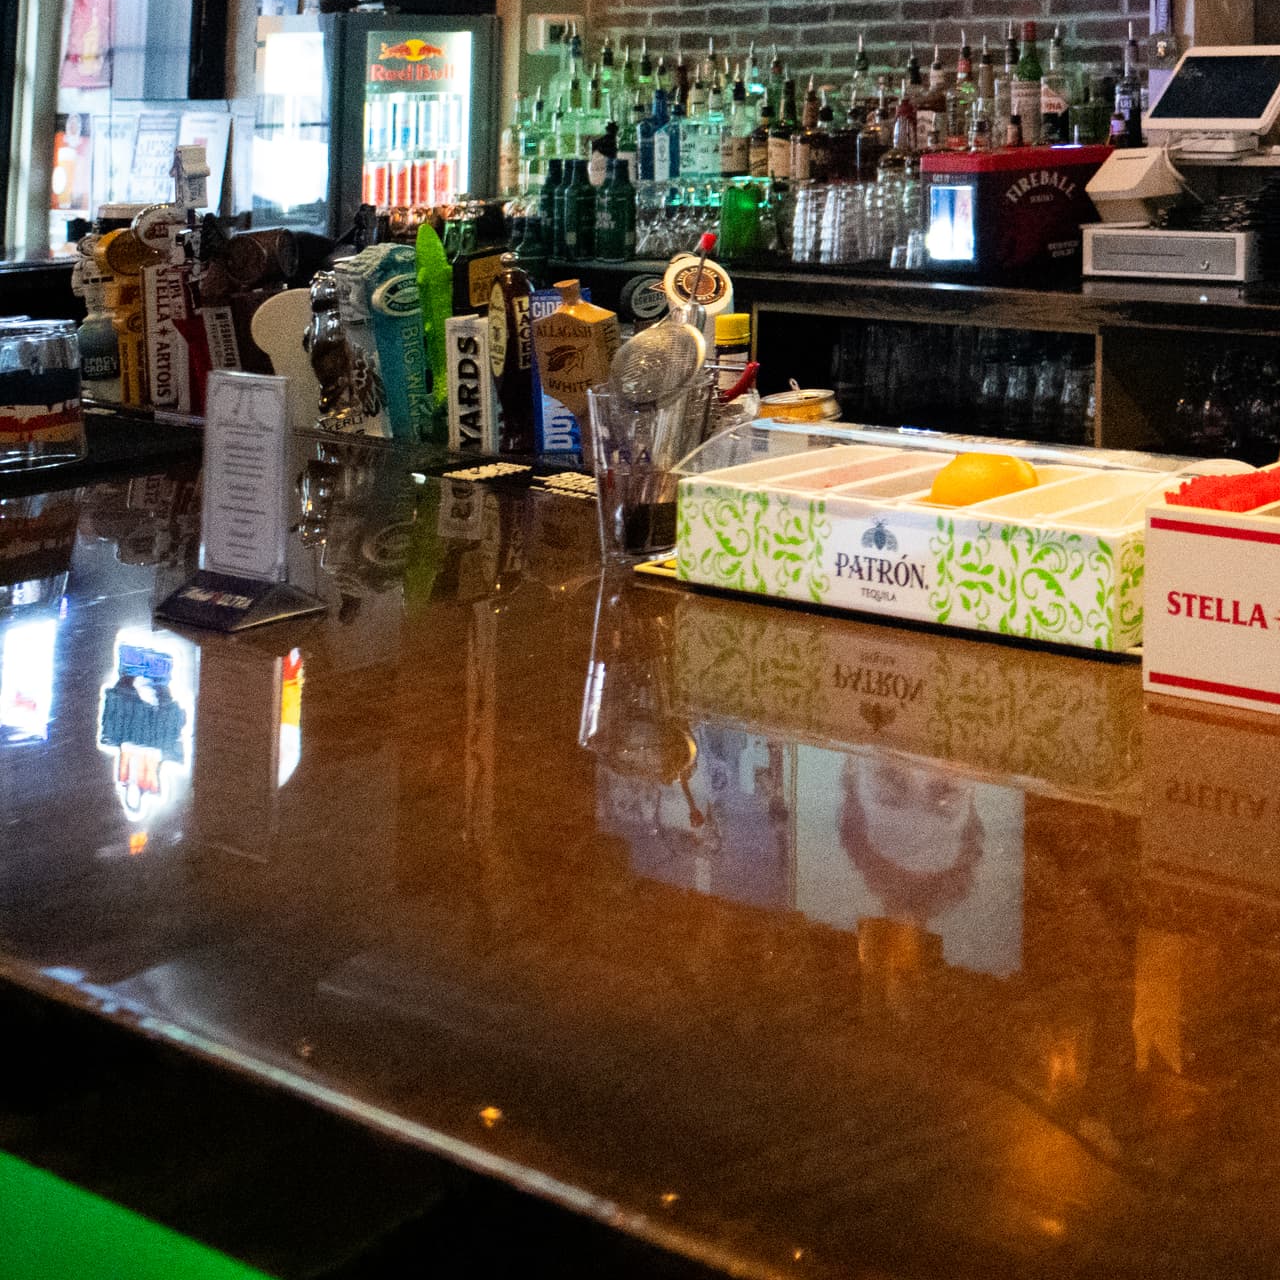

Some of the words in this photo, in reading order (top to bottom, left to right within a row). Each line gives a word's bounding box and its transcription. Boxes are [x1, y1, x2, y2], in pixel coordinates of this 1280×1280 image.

[370, 64, 412, 81] Red
[417, 64, 455, 81] Bull
[1006, 170, 1077, 205] FIREBALL
[155, 268, 167, 323] STELLA
[402, 325, 421, 365] BIG
[513, 296, 532, 370] LAGER
[537, 325, 593, 338] ALLAGASH
[155, 341, 172, 399] ARTOIS
[550, 379, 593, 394] WHITE
[458, 336, 481, 448] YARDS
[861, 587, 897, 602] TEQUILA
[1167, 590, 1269, 630] STELLA
